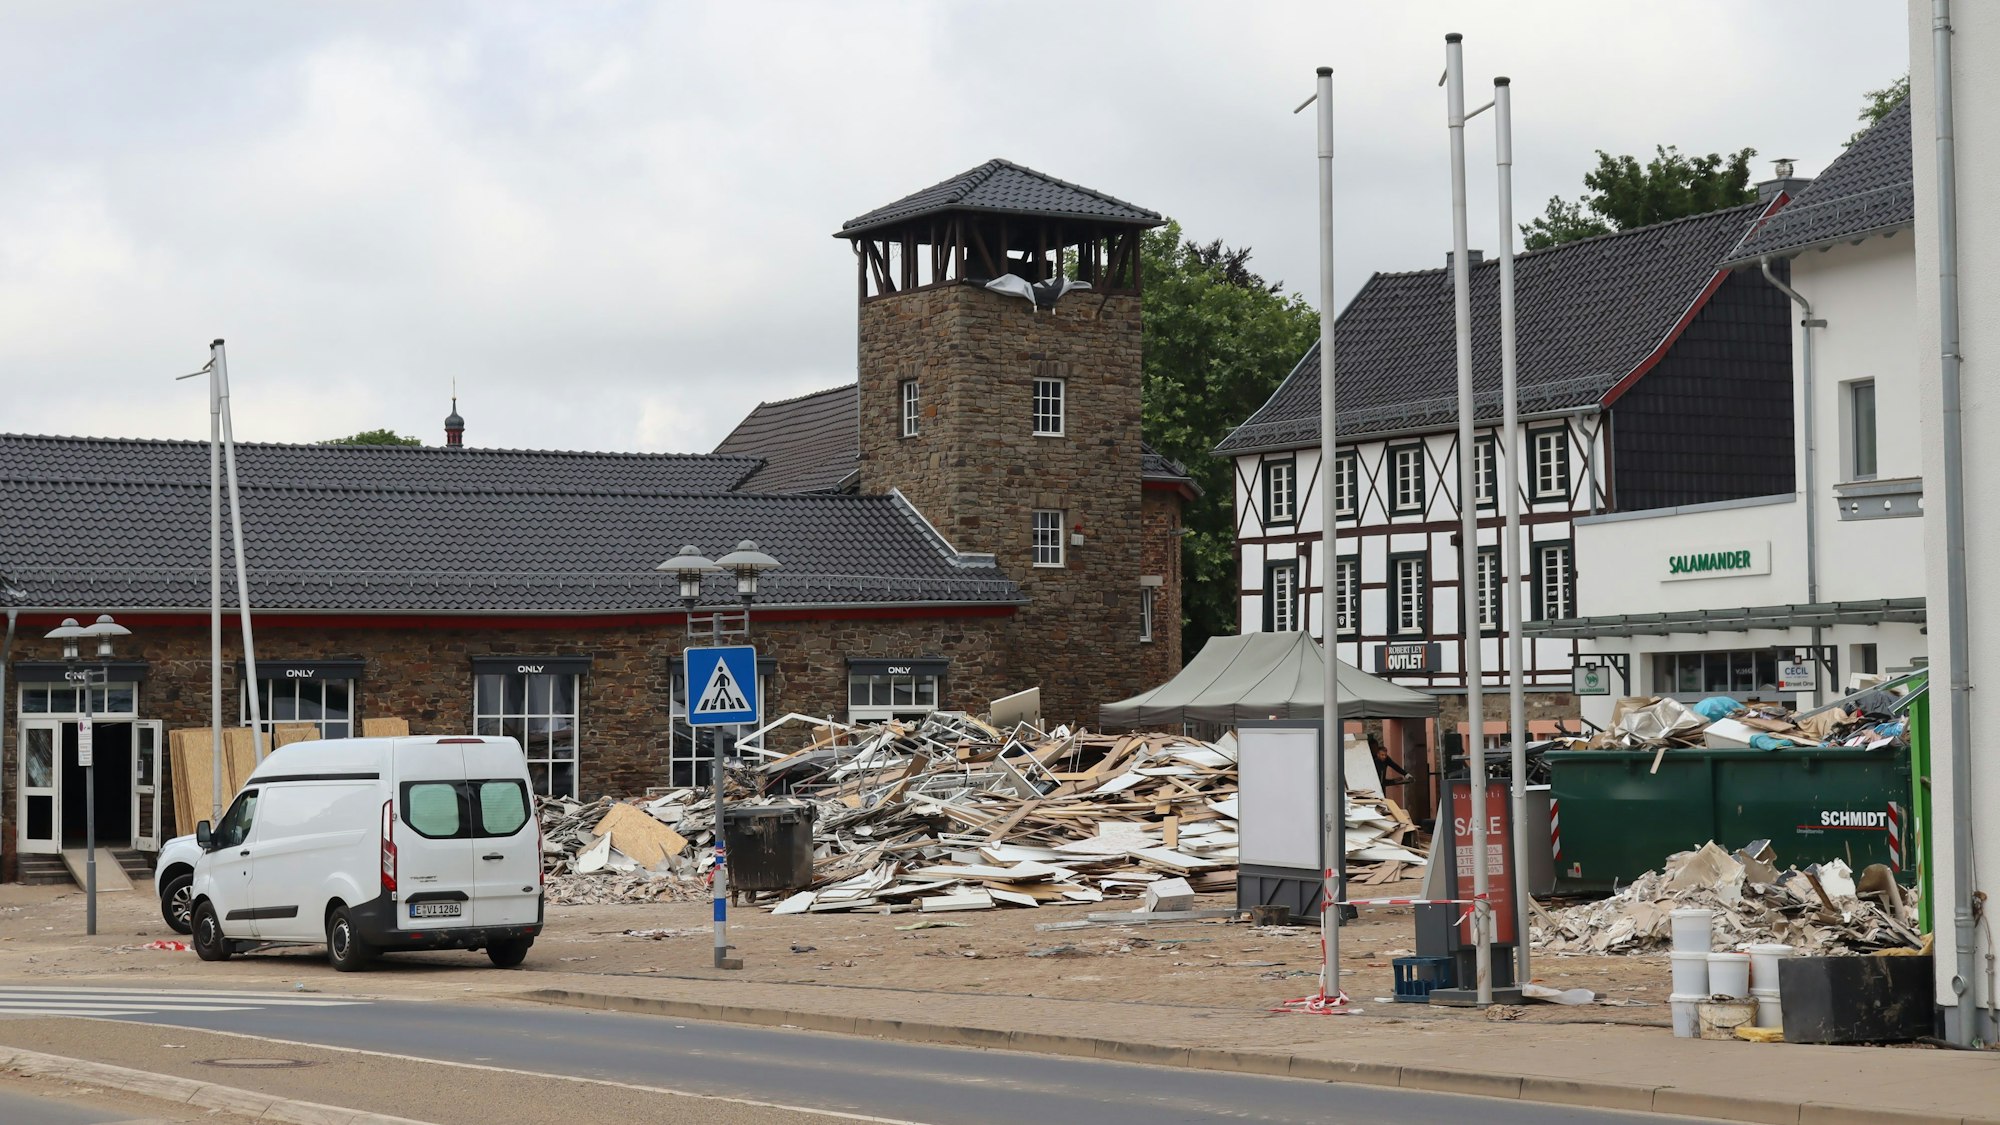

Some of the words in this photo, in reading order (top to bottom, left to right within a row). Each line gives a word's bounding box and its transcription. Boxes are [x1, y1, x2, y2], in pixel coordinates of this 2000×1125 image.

[1669, 550, 1751, 574] SALAMANDER
[1389, 646, 1410, 654] ROBERT
[1411, 645, 1422, 653] LEY
[1388, 654, 1422, 670] OUTLET
[286, 669, 315, 678] ONLY
[517, 665, 544, 673] ONLY
[888, 666, 911, 674] ONLY
[1784, 667, 1808, 675] CECIL
[1820, 810, 1887, 827] SCHMIDT
[416, 905, 421, 915] E
[427, 905, 437, 914] VI
[439, 904, 459, 914] 1286
